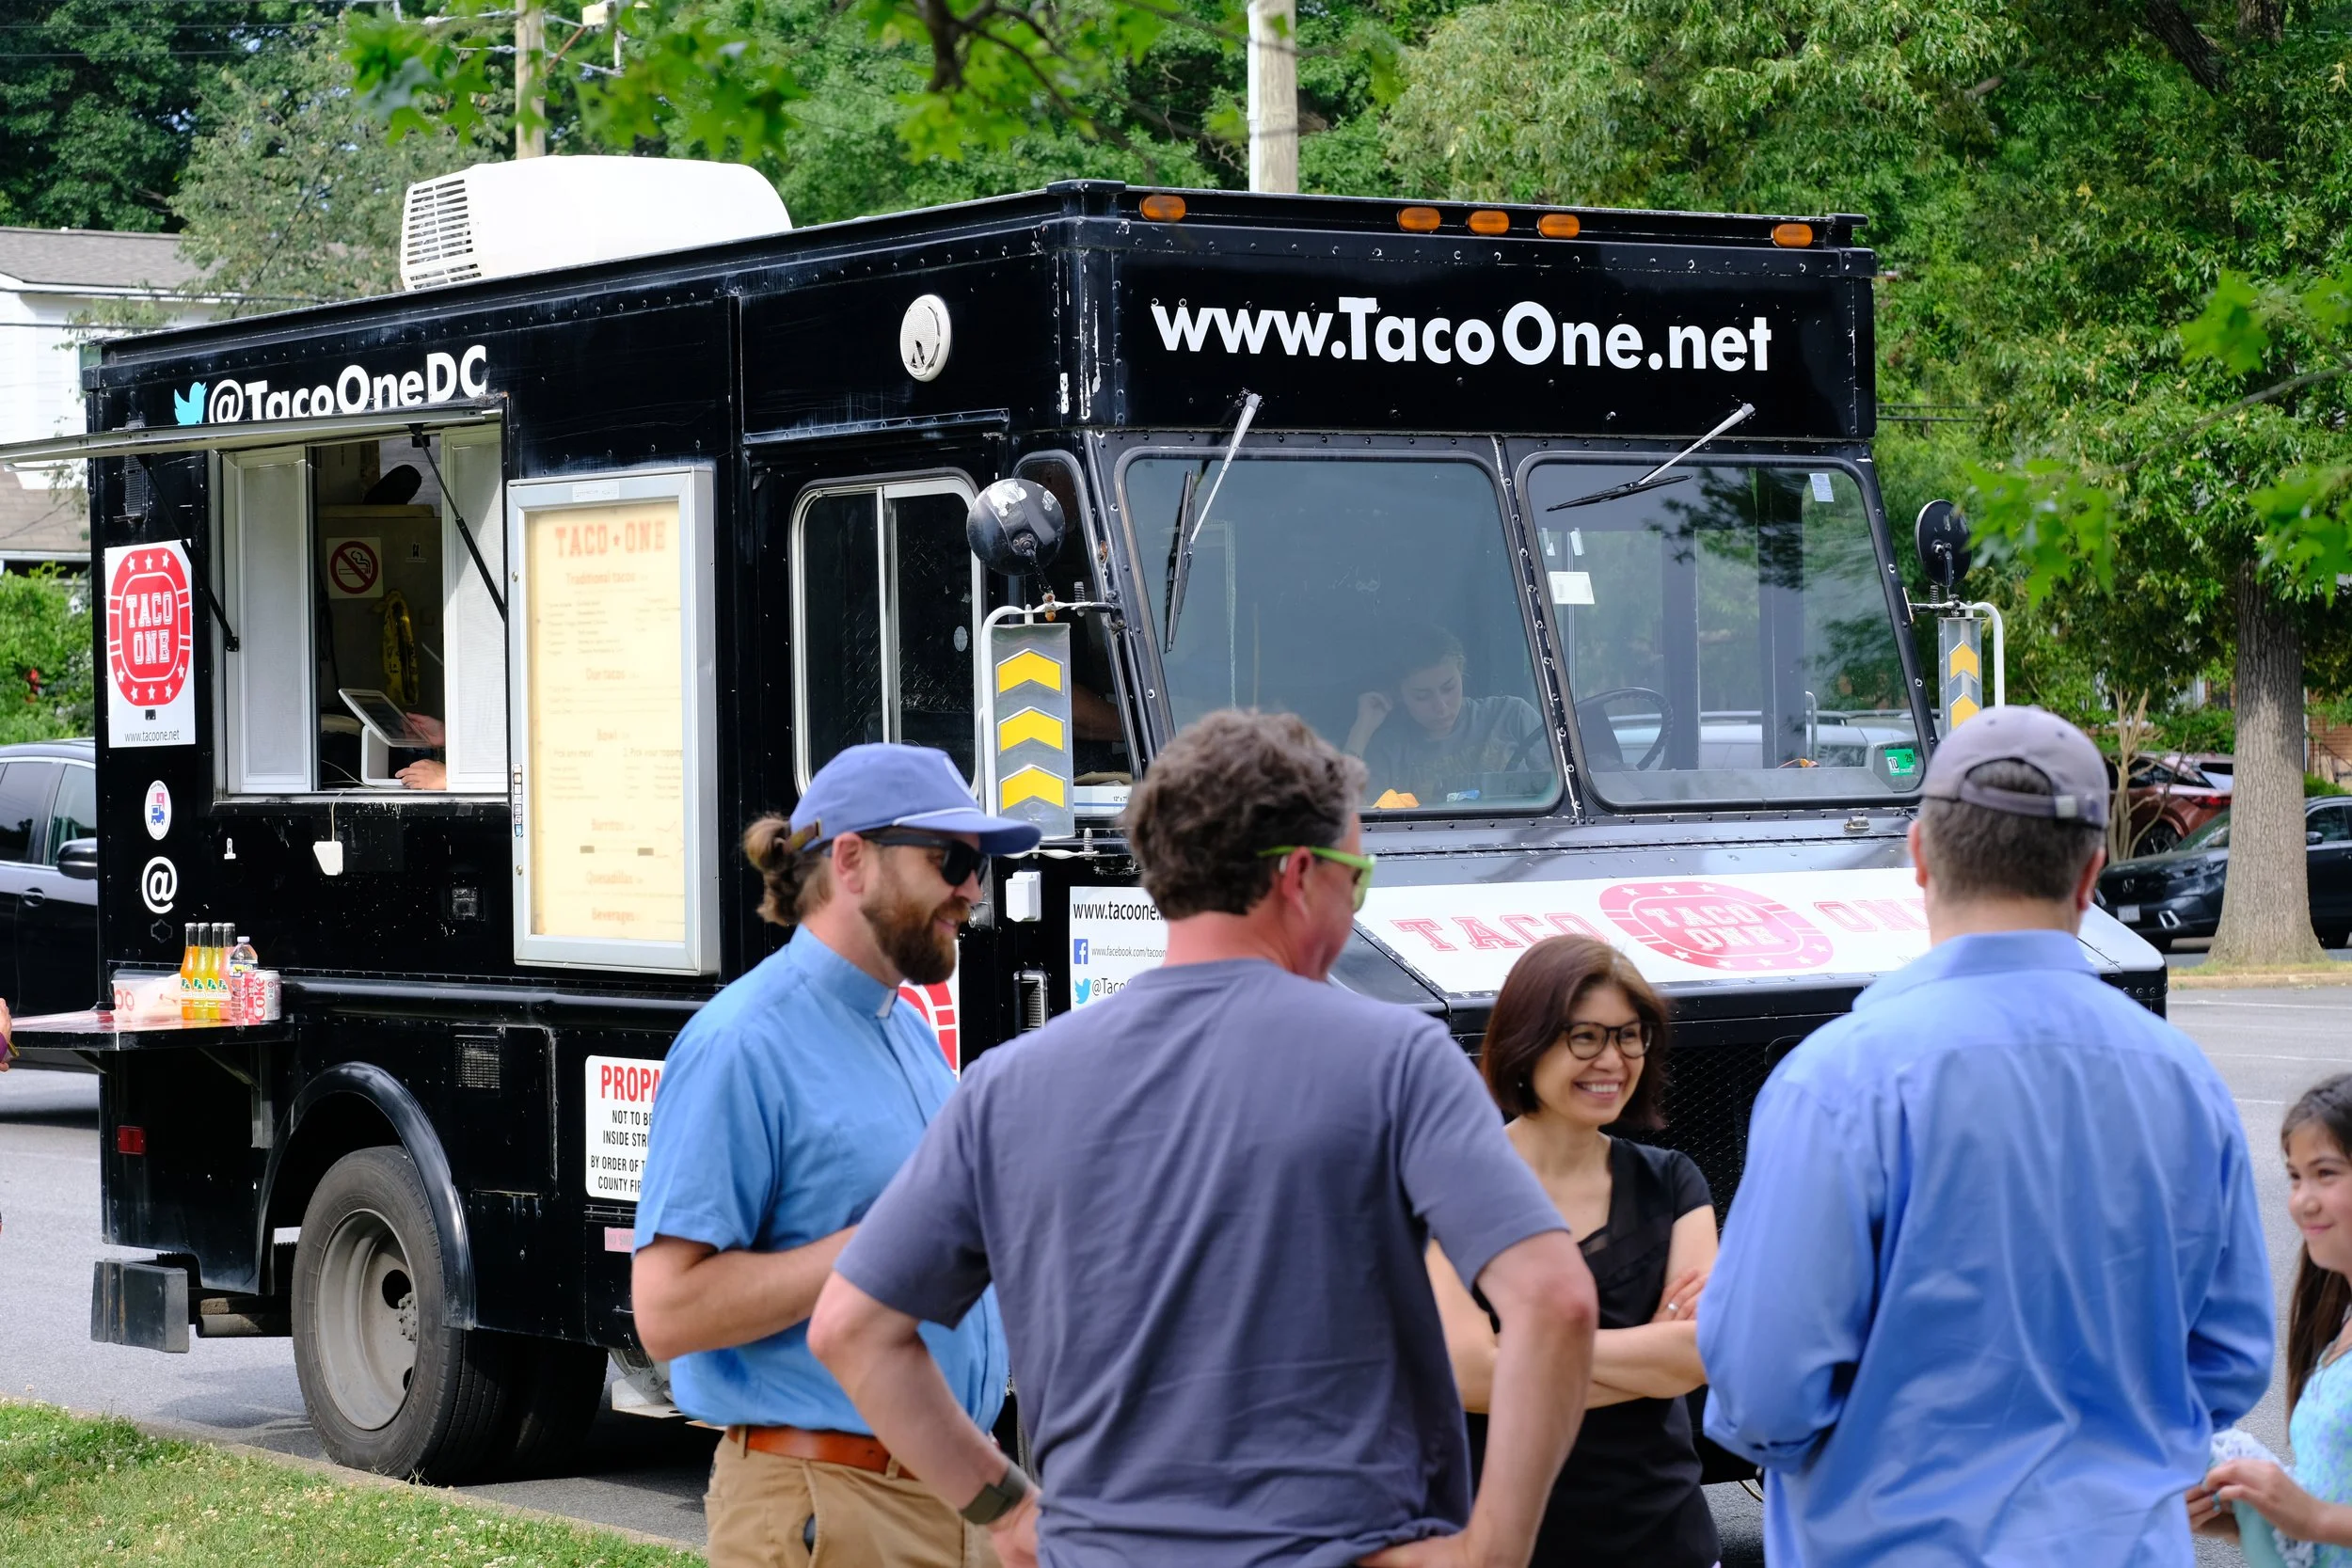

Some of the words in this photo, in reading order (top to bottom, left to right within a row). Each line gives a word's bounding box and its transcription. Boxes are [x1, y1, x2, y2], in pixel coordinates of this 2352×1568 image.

[1151, 296, 1772, 372] www.TacoOne.net
[208, 344, 487, 423] @TacoOneDC
[555, 521, 609, 558] TACO
[625, 519, 666, 553] ONE
[125, 591, 173, 629] TACO
[133, 628, 170, 665] ONE
[124, 729, 180, 742] www.tacoone.net
[1889, 758, 1899, 768] 10
[1639, 903, 1763, 927] TACO
[612, 1110, 628, 1124] NOT
[630, 1111, 640, 1126] TO
[603, 1130, 628, 1146] INSIDE
[591, 1154, 599, 1168] BY
[602, 1156, 627, 1172] ORDER
[629, 1158, 639, 1172] OF
[598, 1176, 628, 1192] COUNTY
